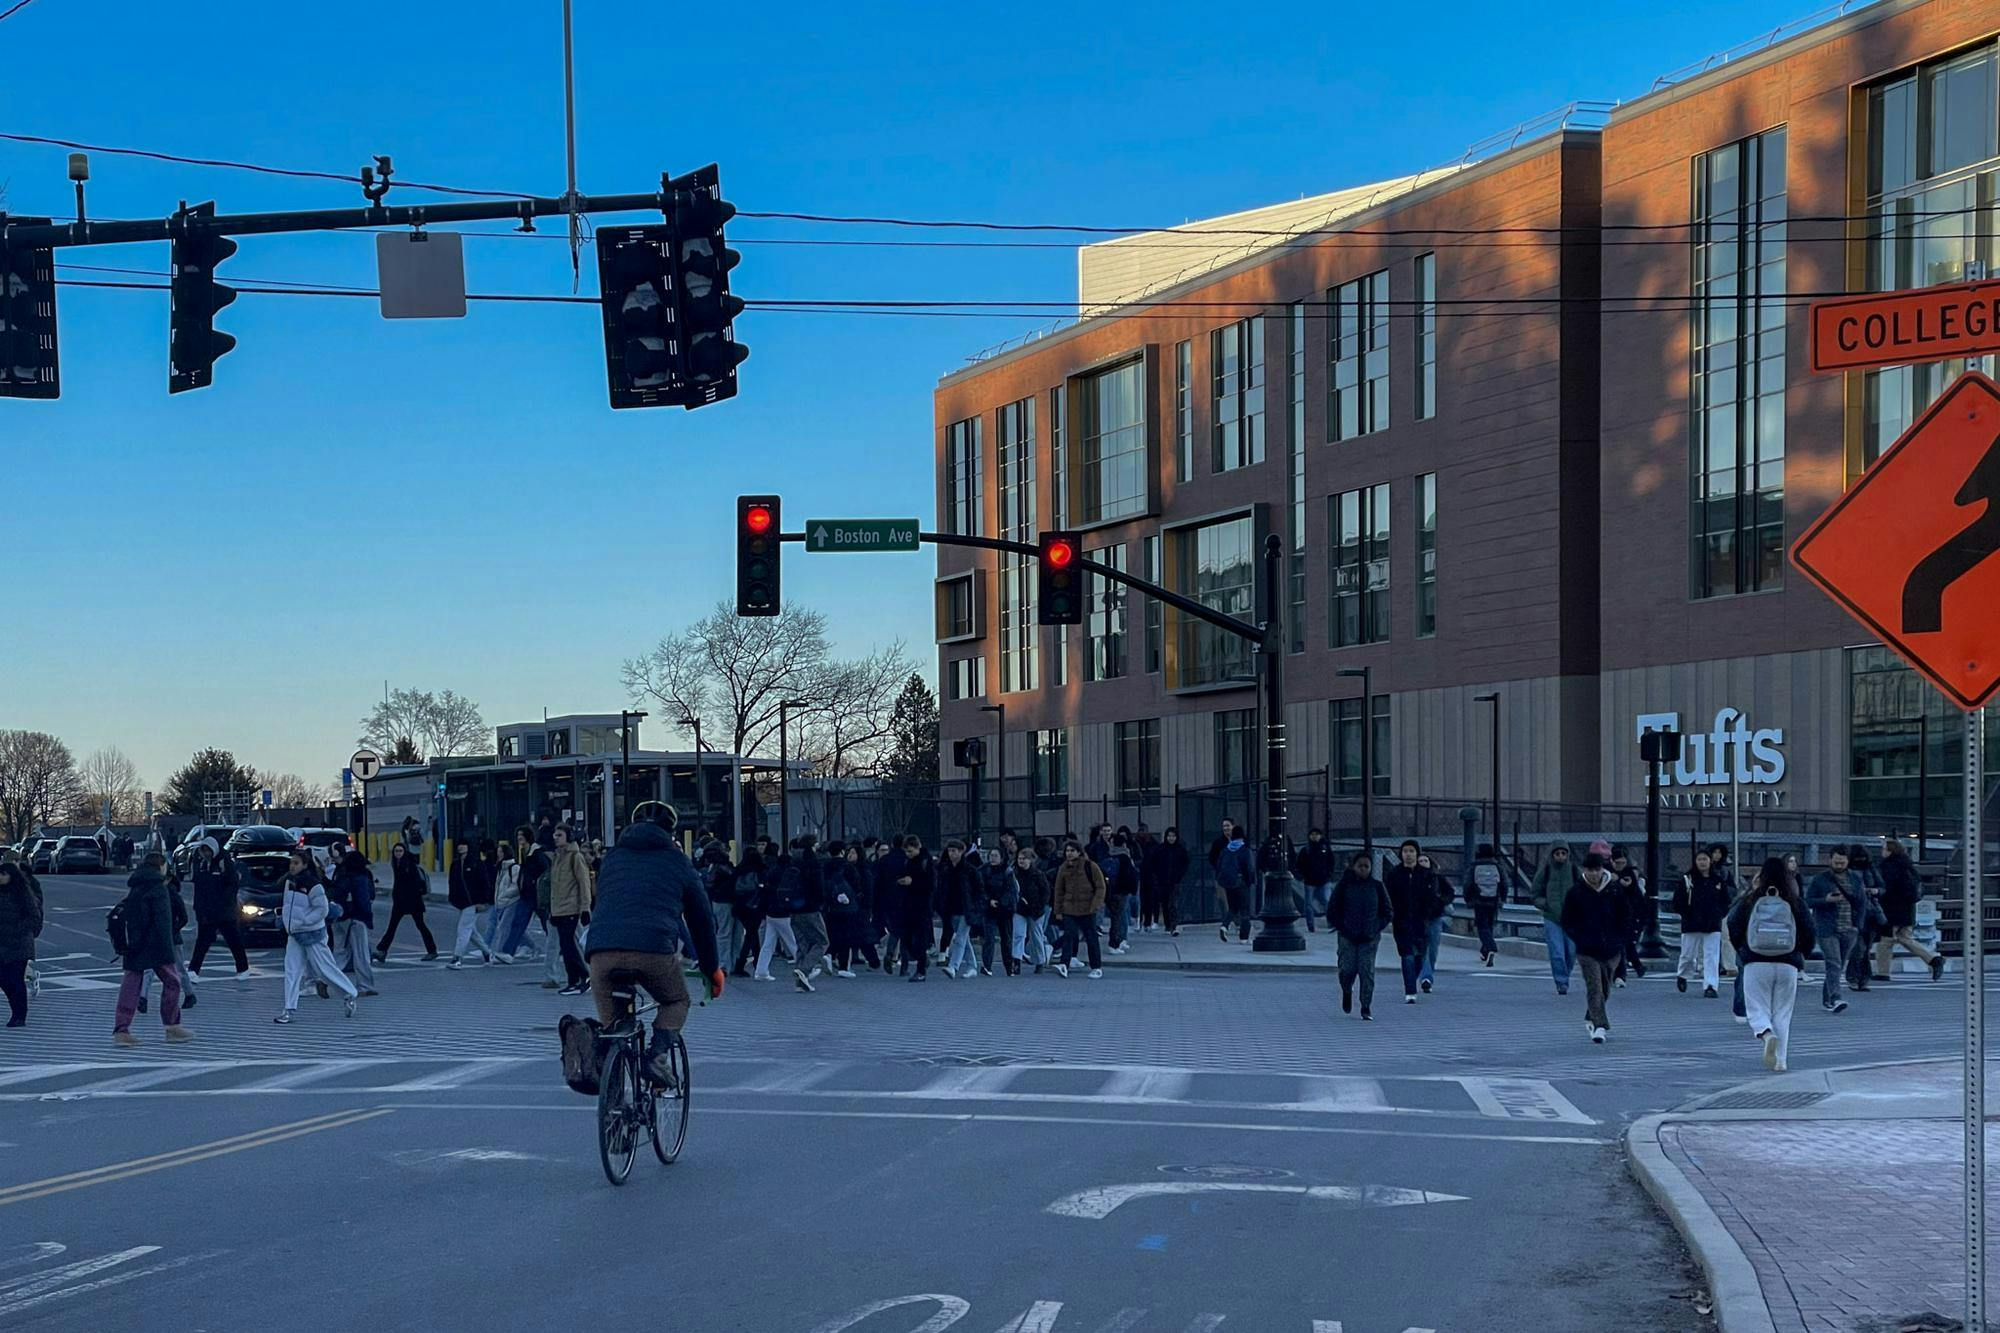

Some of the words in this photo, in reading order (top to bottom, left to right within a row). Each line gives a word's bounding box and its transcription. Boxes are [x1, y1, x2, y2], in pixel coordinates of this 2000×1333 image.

[835, 528, 880, 543] Boston
[888, 527, 913, 543] Ave
[1637, 707, 1785, 785] Tufts
[355, 757, 375, 775] T
[1646, 790, 1785, 808] NIVERITY
